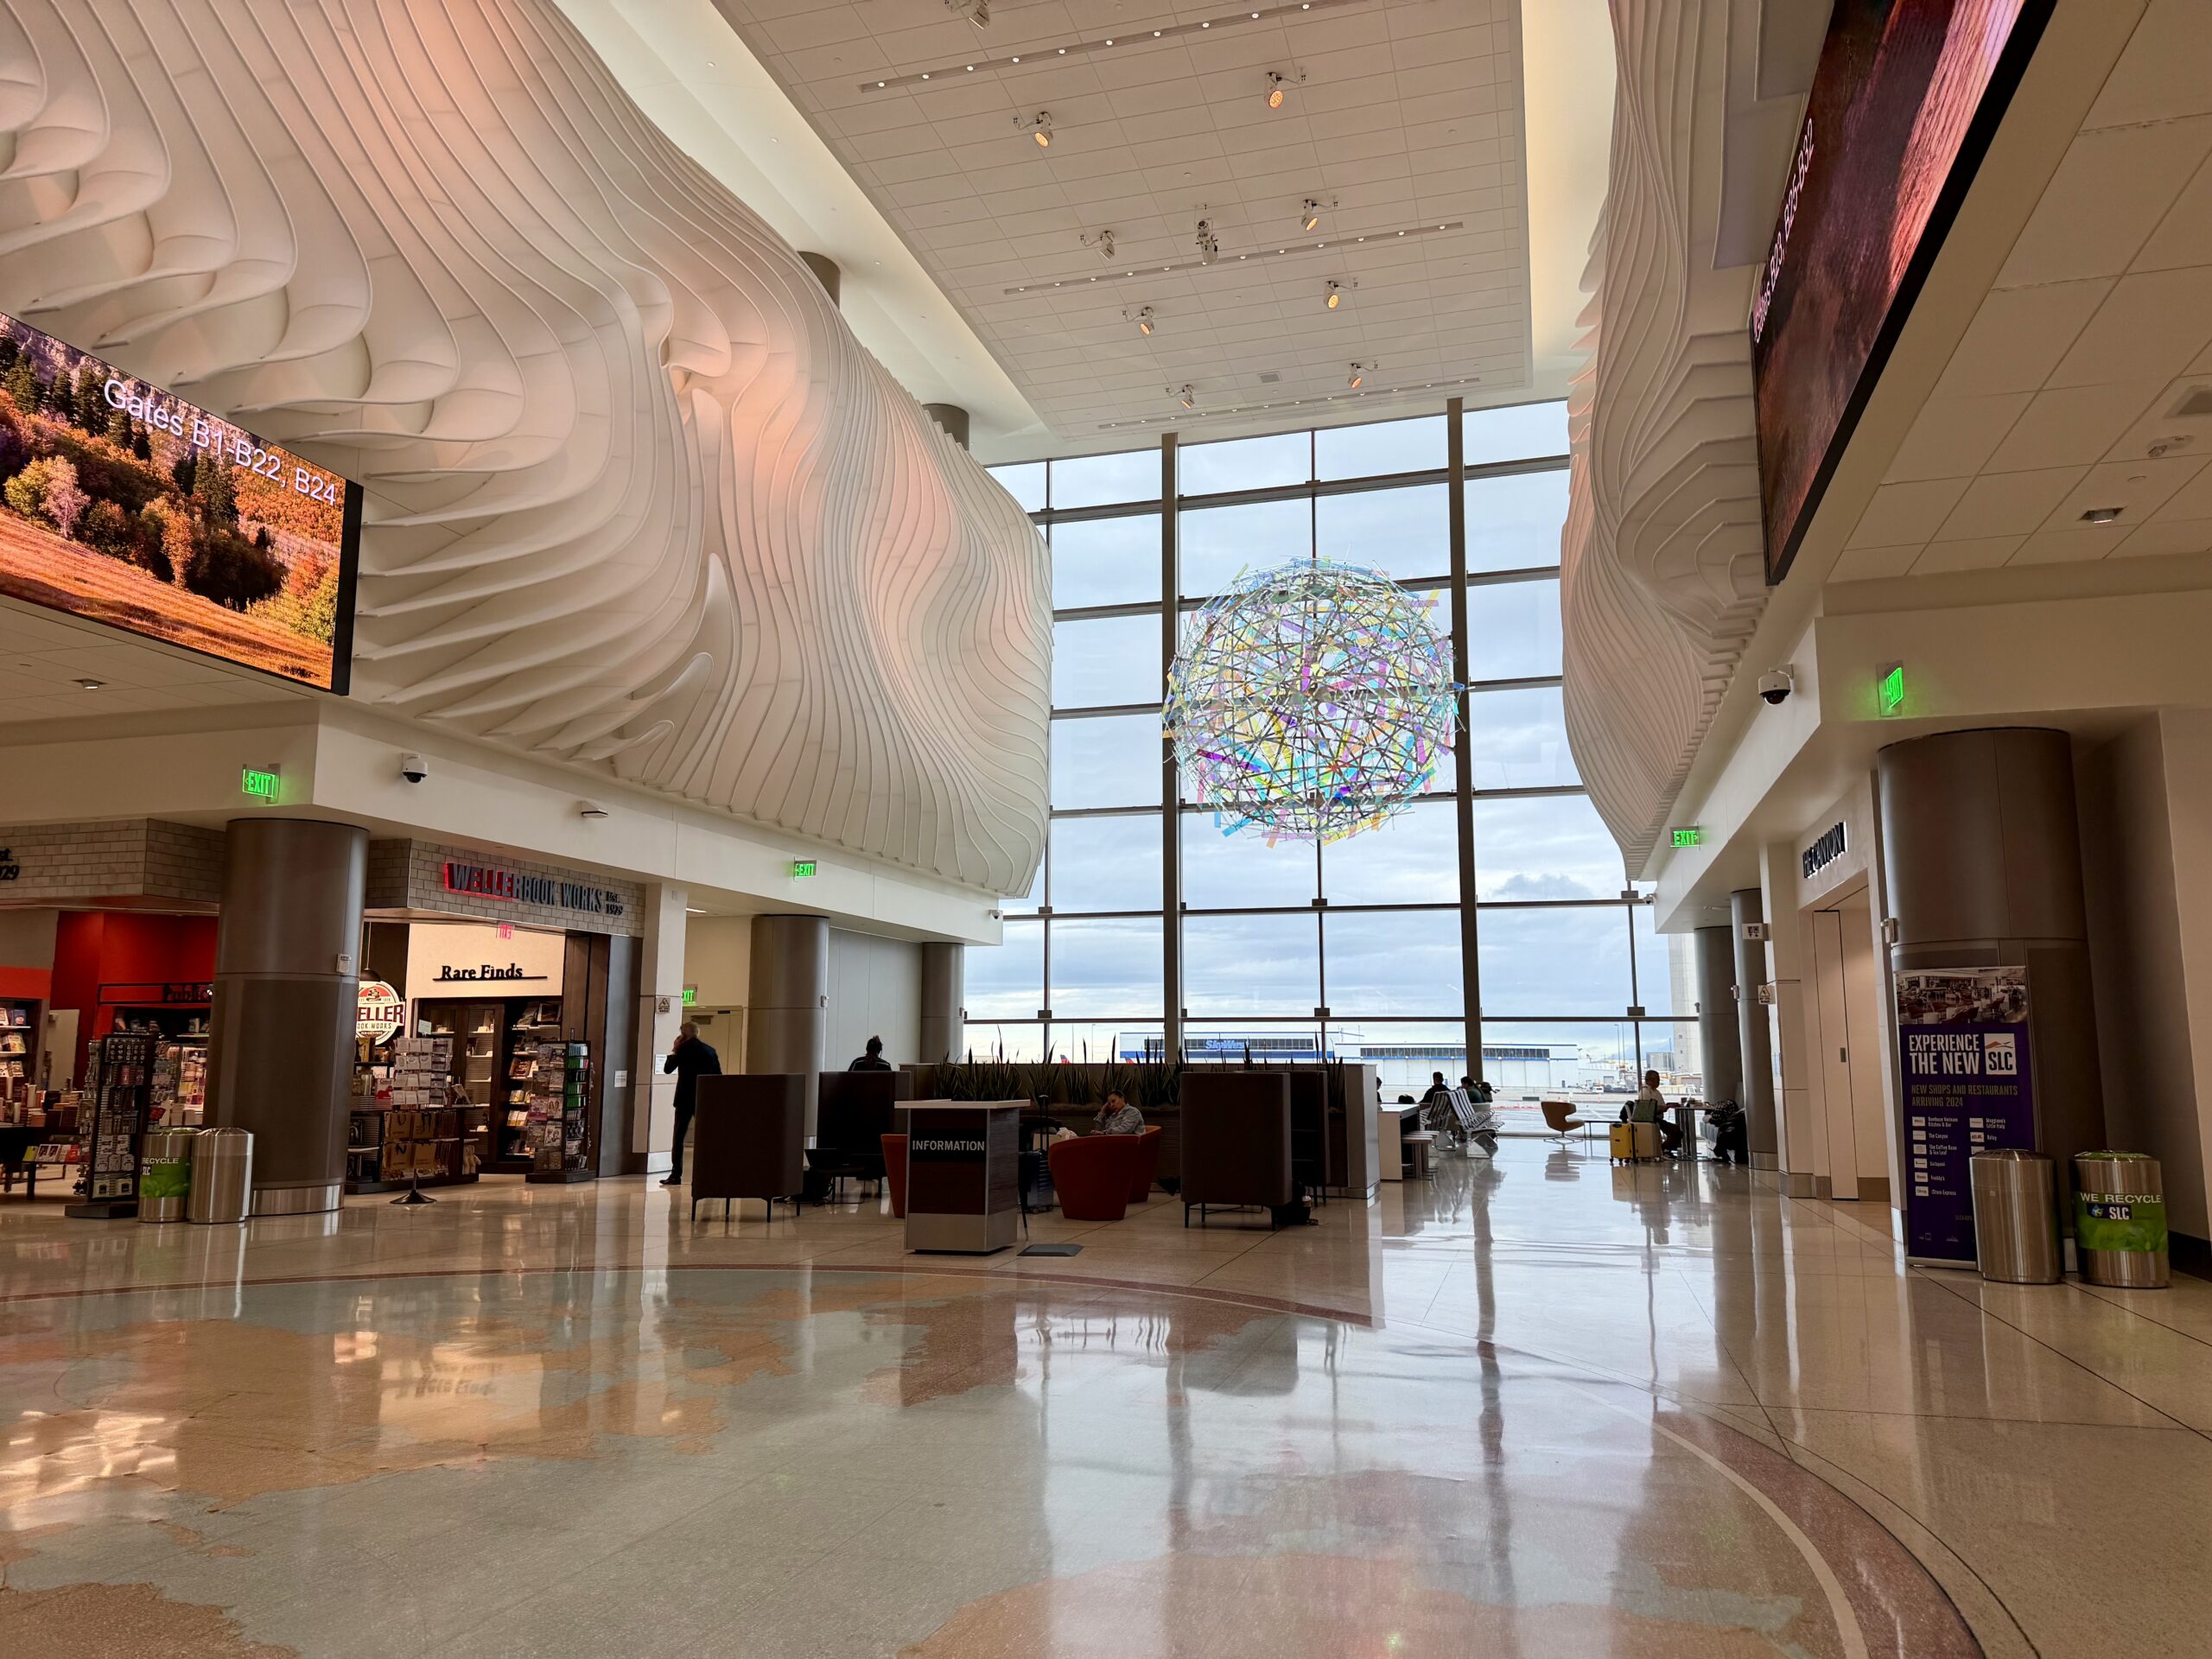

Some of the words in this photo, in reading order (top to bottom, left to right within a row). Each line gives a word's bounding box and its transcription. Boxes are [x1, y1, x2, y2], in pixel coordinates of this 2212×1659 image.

[1754, 288, 1771, 344] Gates
[1783, 118, 1815, 242] B25-B32
[104, 378, 182, 437] Gates
[193, 418, 288, 489] B1-B22,
[295, 465, 336, 506] B24
[248, 772, 270, 795] EXIT
[1674, 832, 1694, 846] EXIT
[799, 863, 815, 876] EXIT
[562, 883, 602, 912] WORKS
[442, 965, 477, 979] Rare
[480, 963, 523, 979] Finds
[683, 989, 694, 1001] XIT
[358, 1004, 404, 1024] ELLER
[1908, 1033, 1980, 1052] EXPERIENCE
[1909, 1052, 1938, 1075] THE
[1942, 1052, 1980, 1075] NEW
[1987, 1052, 2013, 1071] SLC
[1911, 1084, 1928, 1095] NEW
[1929, 1084, 1951, 1095] SHOPS
[1953, 1085, 1967, 1095] AND
[1968, 1085, 2018, 1096] RESTAURANTS
[1911, 1096, 1943, 1107] ARRIVING
[1946, 1096, 1963, 1107] 2024
[912, 1141, 985, 1151] INFORMATION
[2080, 1192, 2100, 1202] WE
[2105, 1194, 2161, 1204] RECYCLE
[2108, 1206, 2129, 1220] SLC
